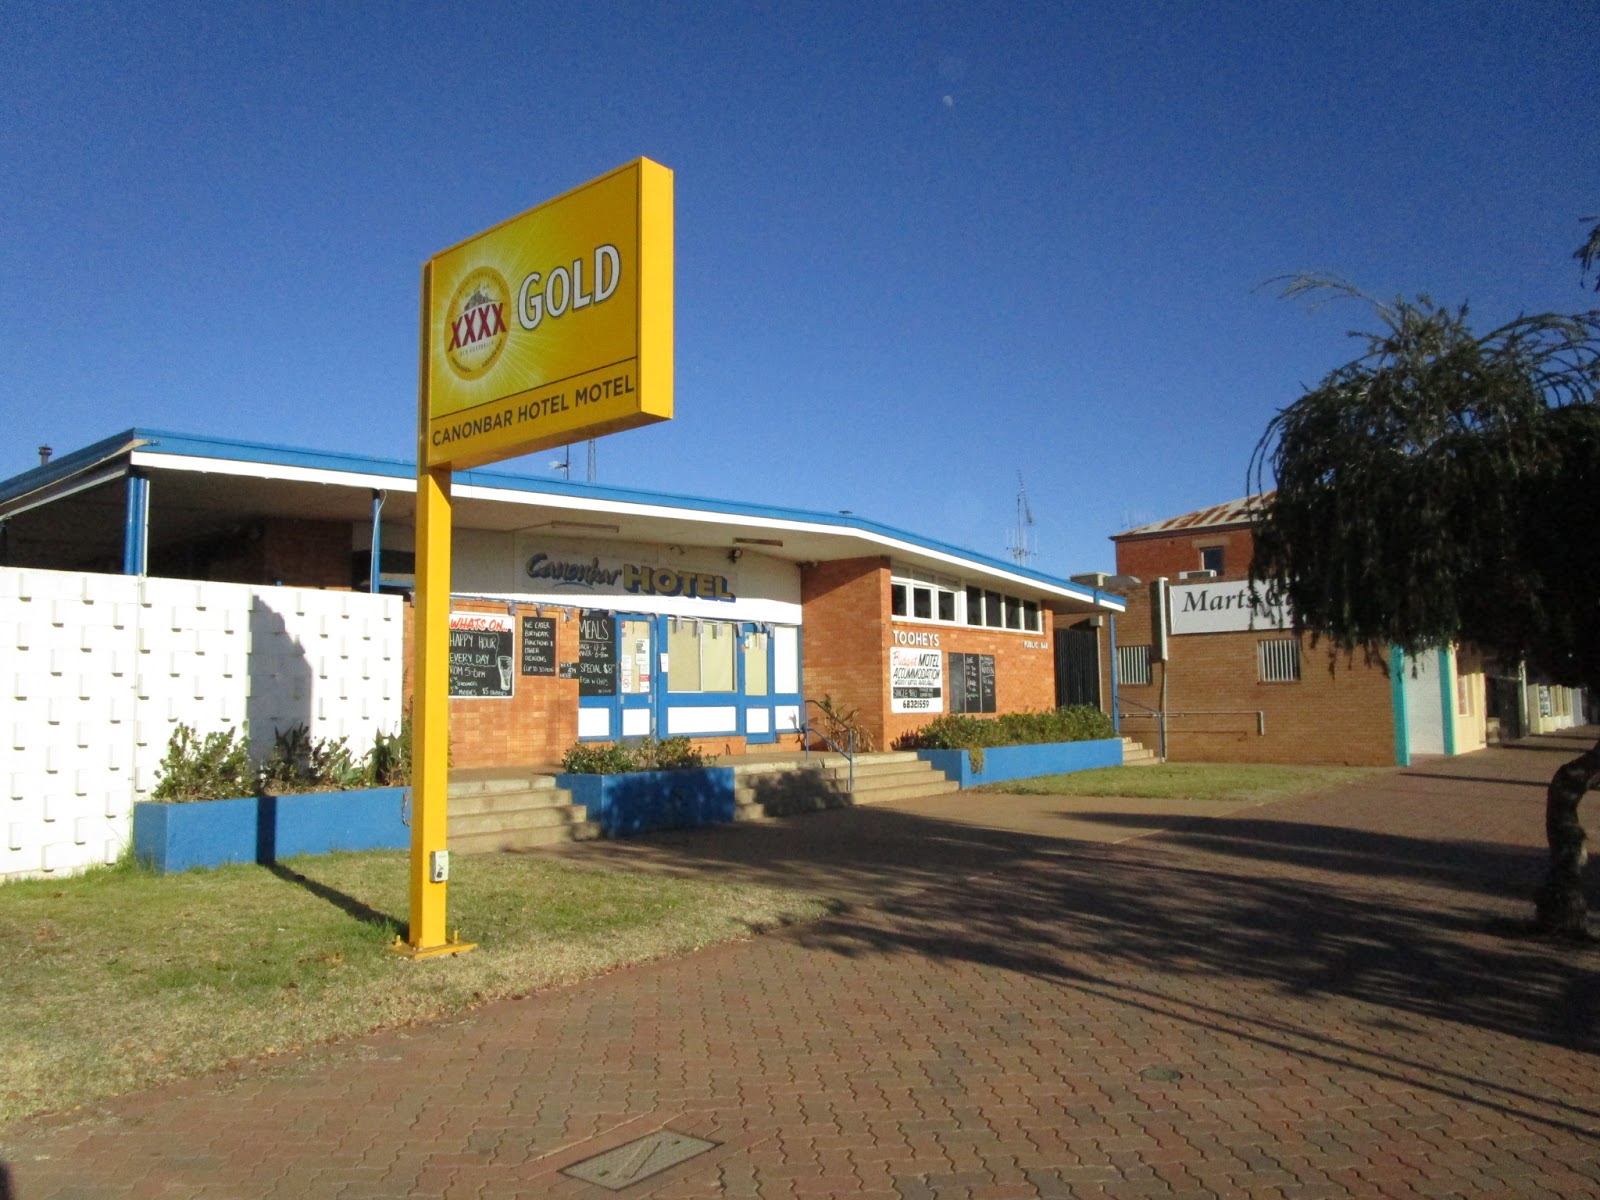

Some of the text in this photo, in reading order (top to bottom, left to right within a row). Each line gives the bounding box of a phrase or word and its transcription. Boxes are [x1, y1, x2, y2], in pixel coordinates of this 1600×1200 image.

[518, 243, 621, 330] GOLD
[448, 303, 507, 352] XXXX
[432, 374, 635, 446] CANONBAR HOTEL MOTEL
[623, 564, 736, 603] HOTEL
[450, 618, 486, 630] WHATS
[449, 633, 497, 650] HAPPY HOUR
[892, 630, 940, 647] TOOHEYS
[449, 652, 490, 665] EVERY DAY
[918, 653, 940, 668] MOTEL
